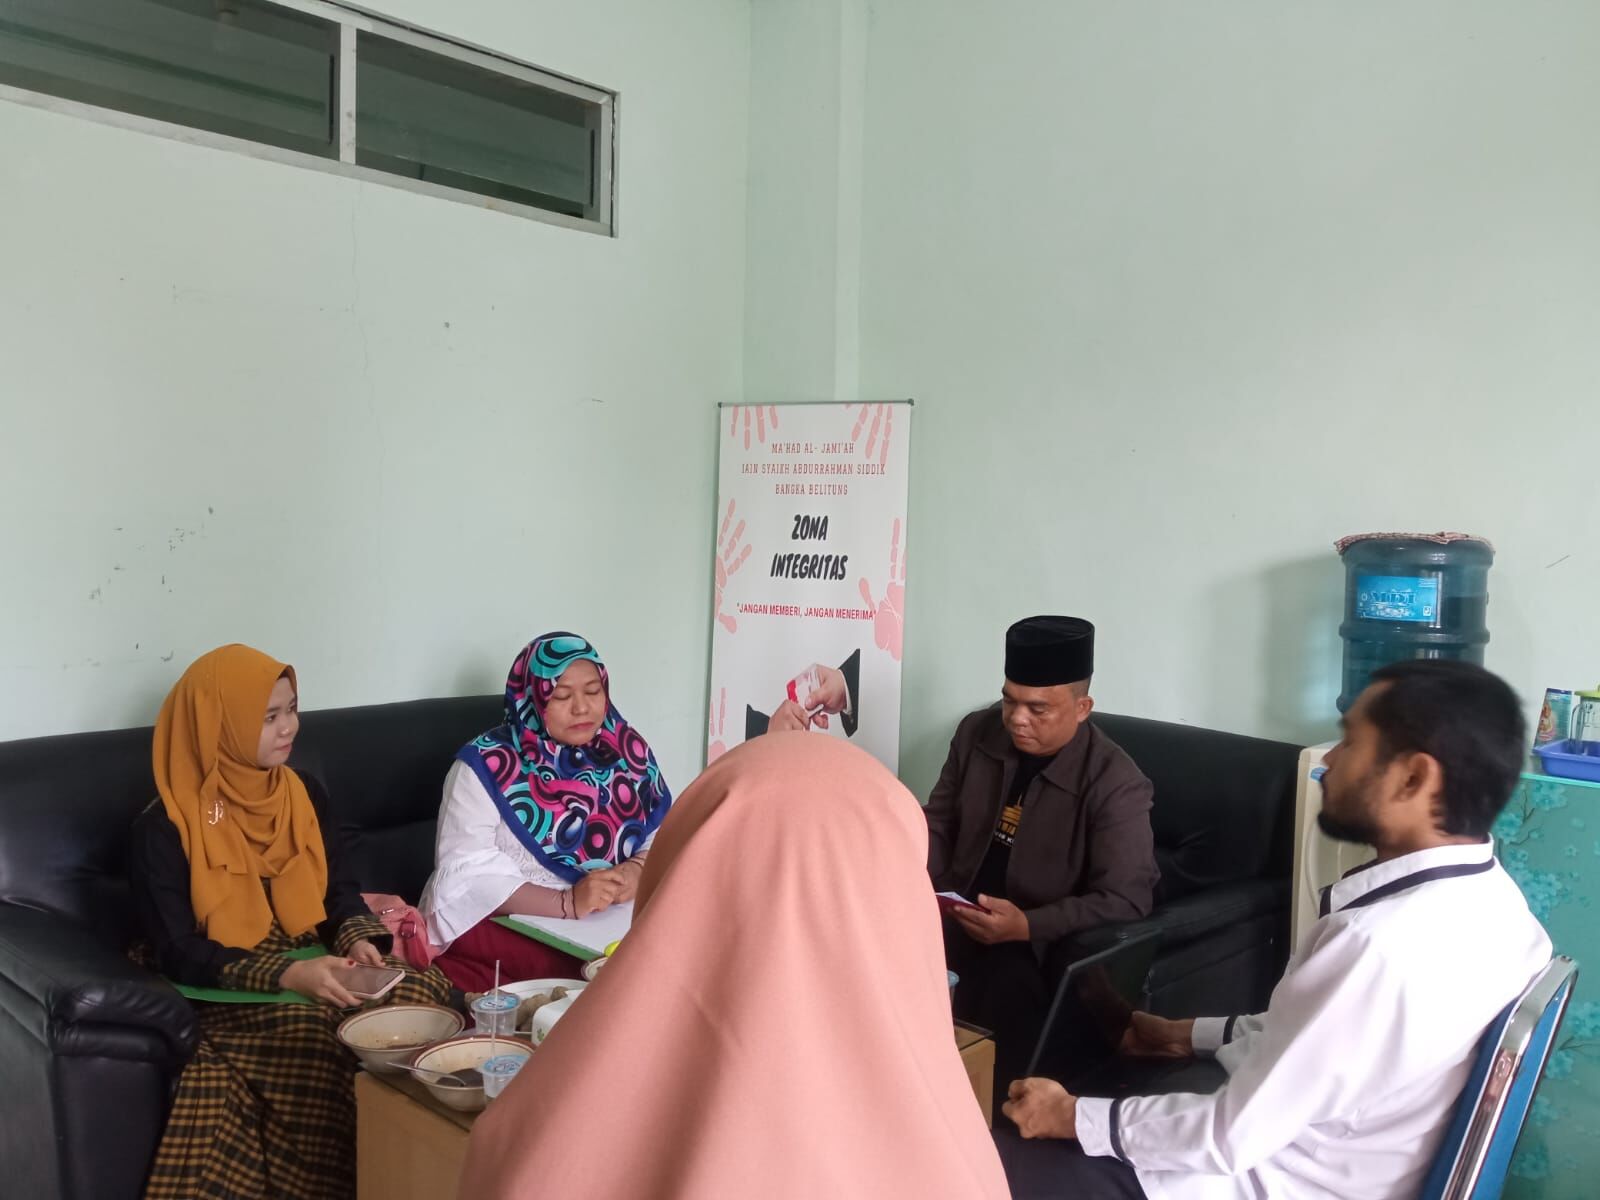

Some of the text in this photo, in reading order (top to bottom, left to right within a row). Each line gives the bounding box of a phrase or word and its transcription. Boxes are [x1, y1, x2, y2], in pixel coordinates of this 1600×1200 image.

[772, 443, 801, 454] MA'HAD
[821, 443, 855, 454] JAMI'AH
[741, 463, 886, 475] IAIN SYAIKH ABDURRAHMAN SIDDIK
[775, 484, 848, 495] BANGKA BELITUNG
[791, 514, 829, 541] ZONA
[770, 553, 848, 580] INTEGRITAS
[769, 605, 802, 618] MEMBERI,
[804, 607, 834, 619] JANGAN
